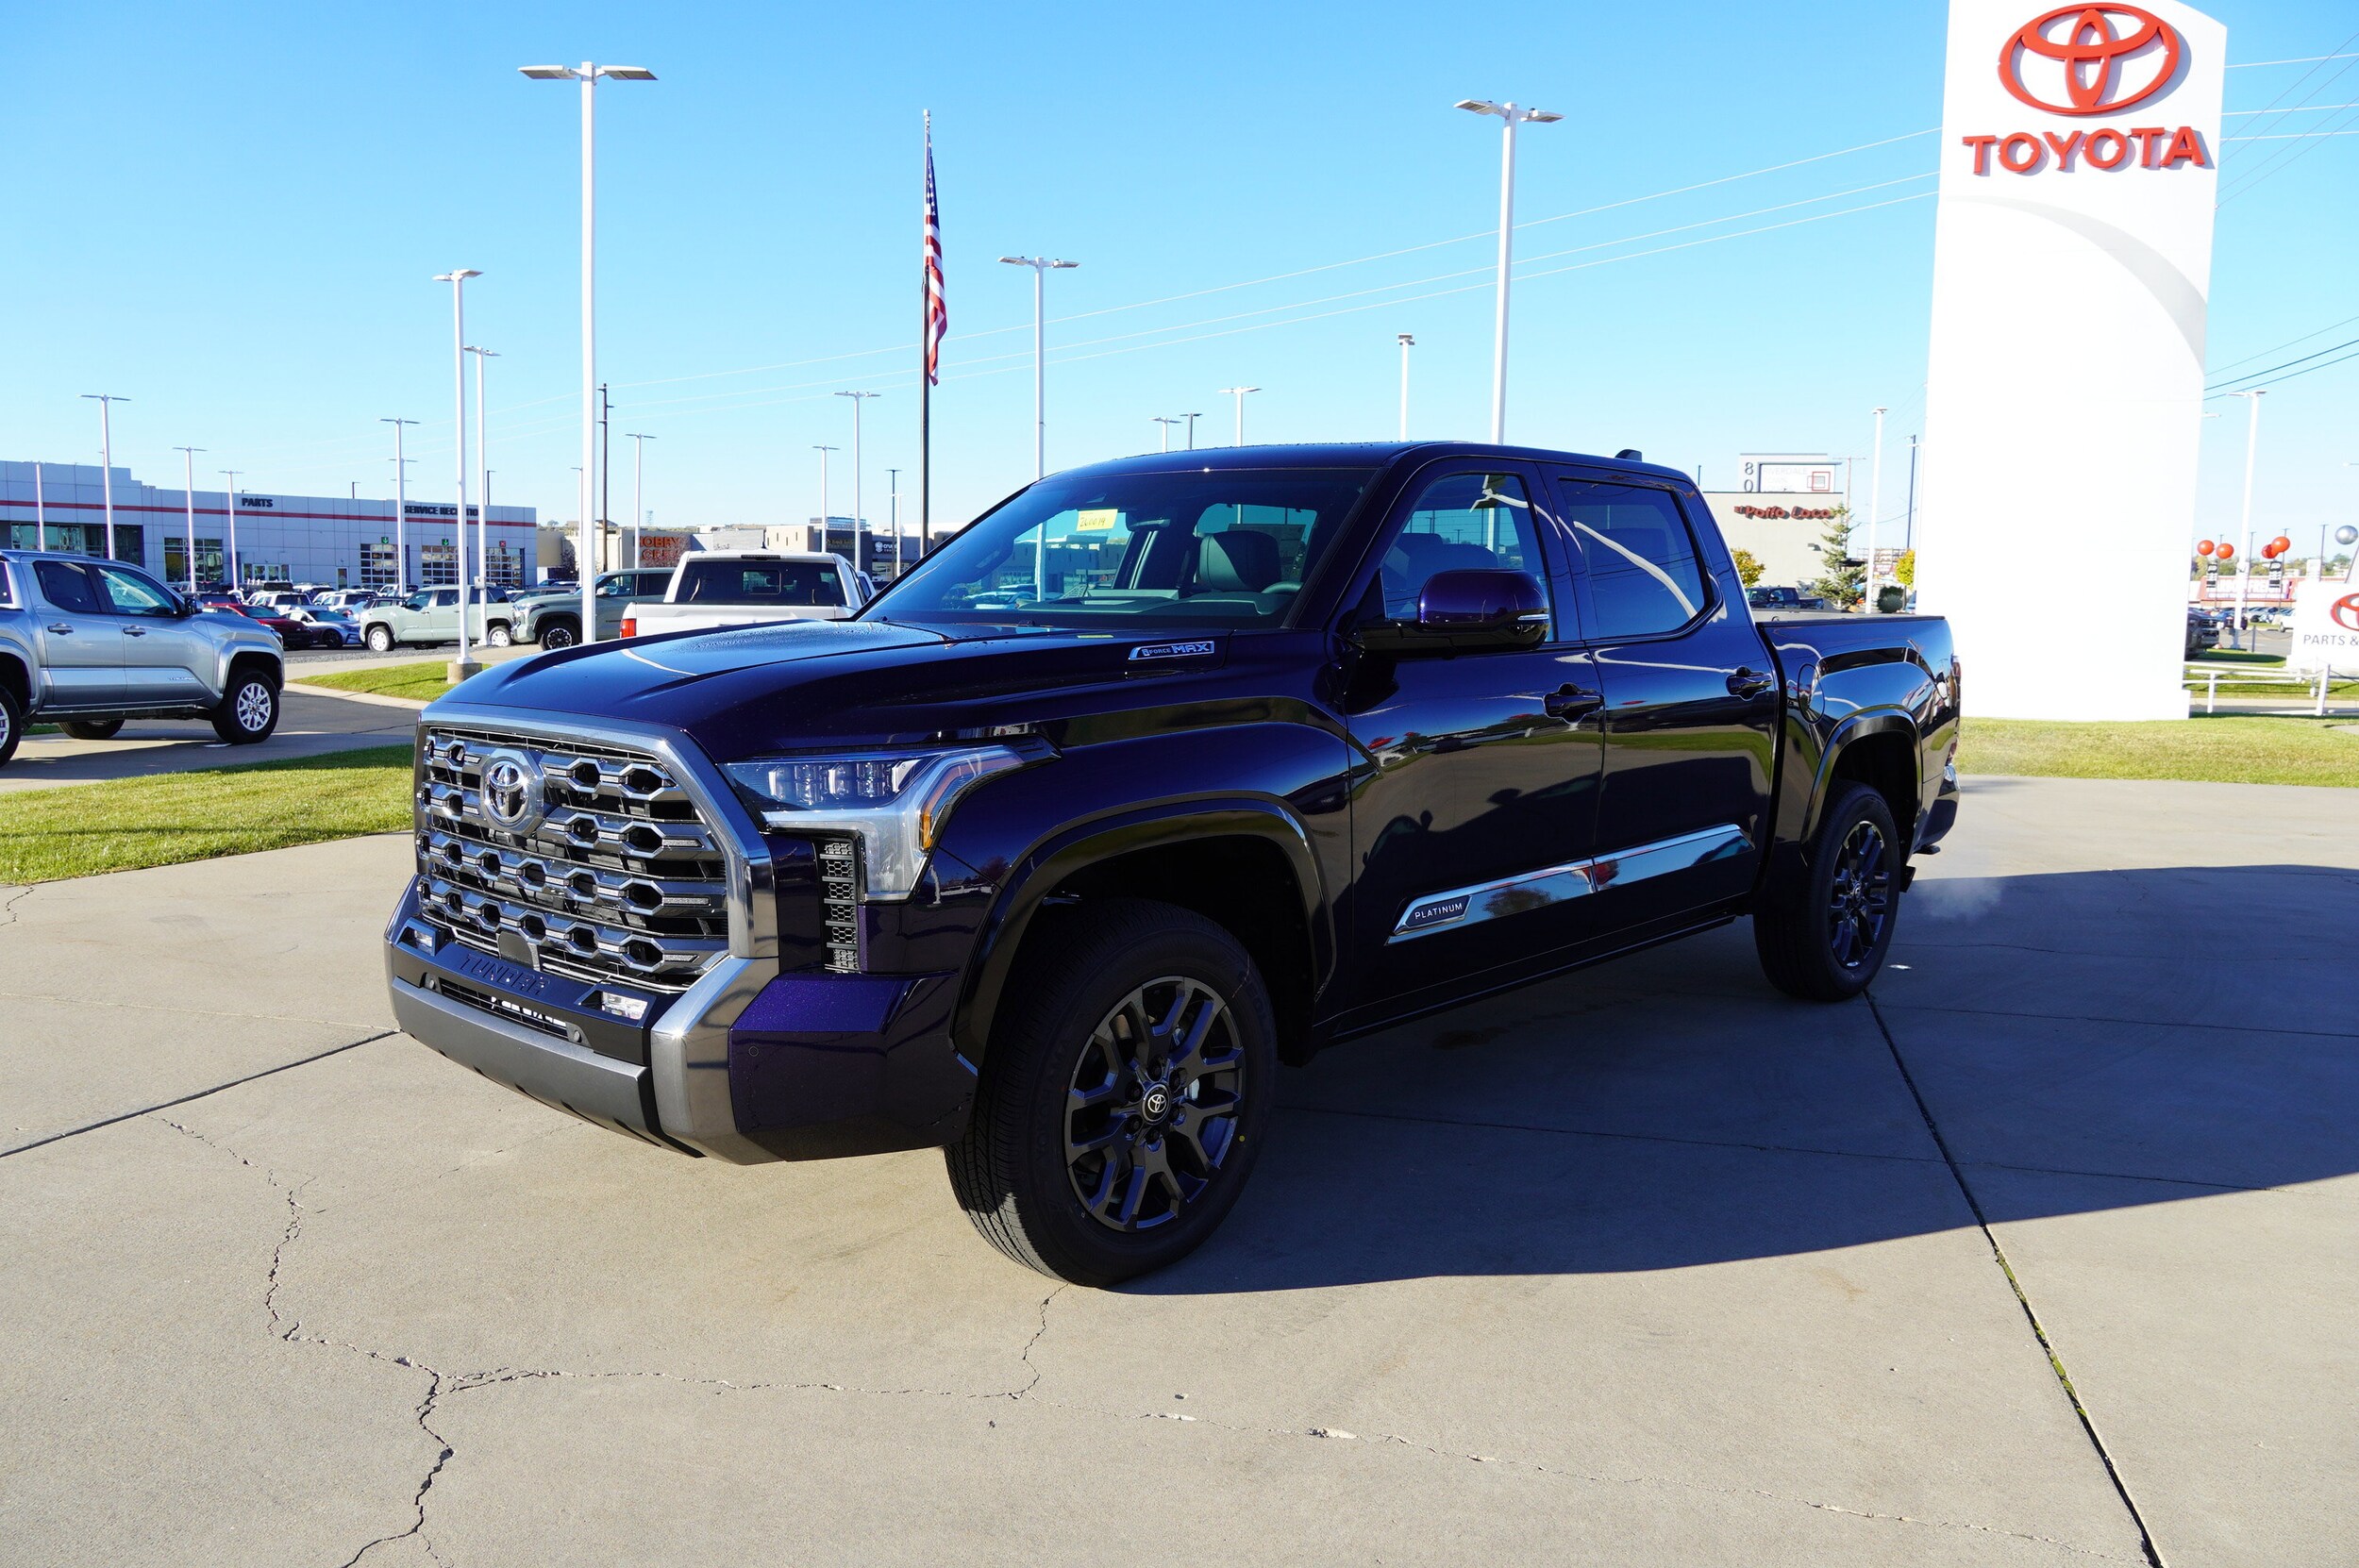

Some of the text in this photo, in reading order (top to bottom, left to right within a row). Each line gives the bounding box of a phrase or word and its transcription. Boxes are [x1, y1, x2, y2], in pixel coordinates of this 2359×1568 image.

[1962, 126, 2205, 175] TOYOTA
[242, 498, 274, 508] PARTS
[405, 506, 438, 515] SERVICE
[1745, 506, 1790, 520] Pollo
[1791, 506, 1834, 520] Loco
[2303, 634, 2359, 646] PARTS &
[1172, 642, 1210, 654] MAX
[1414, 902, 1463, 920] PLATINUM
[460, 952, 551, 996] TUNDRA
